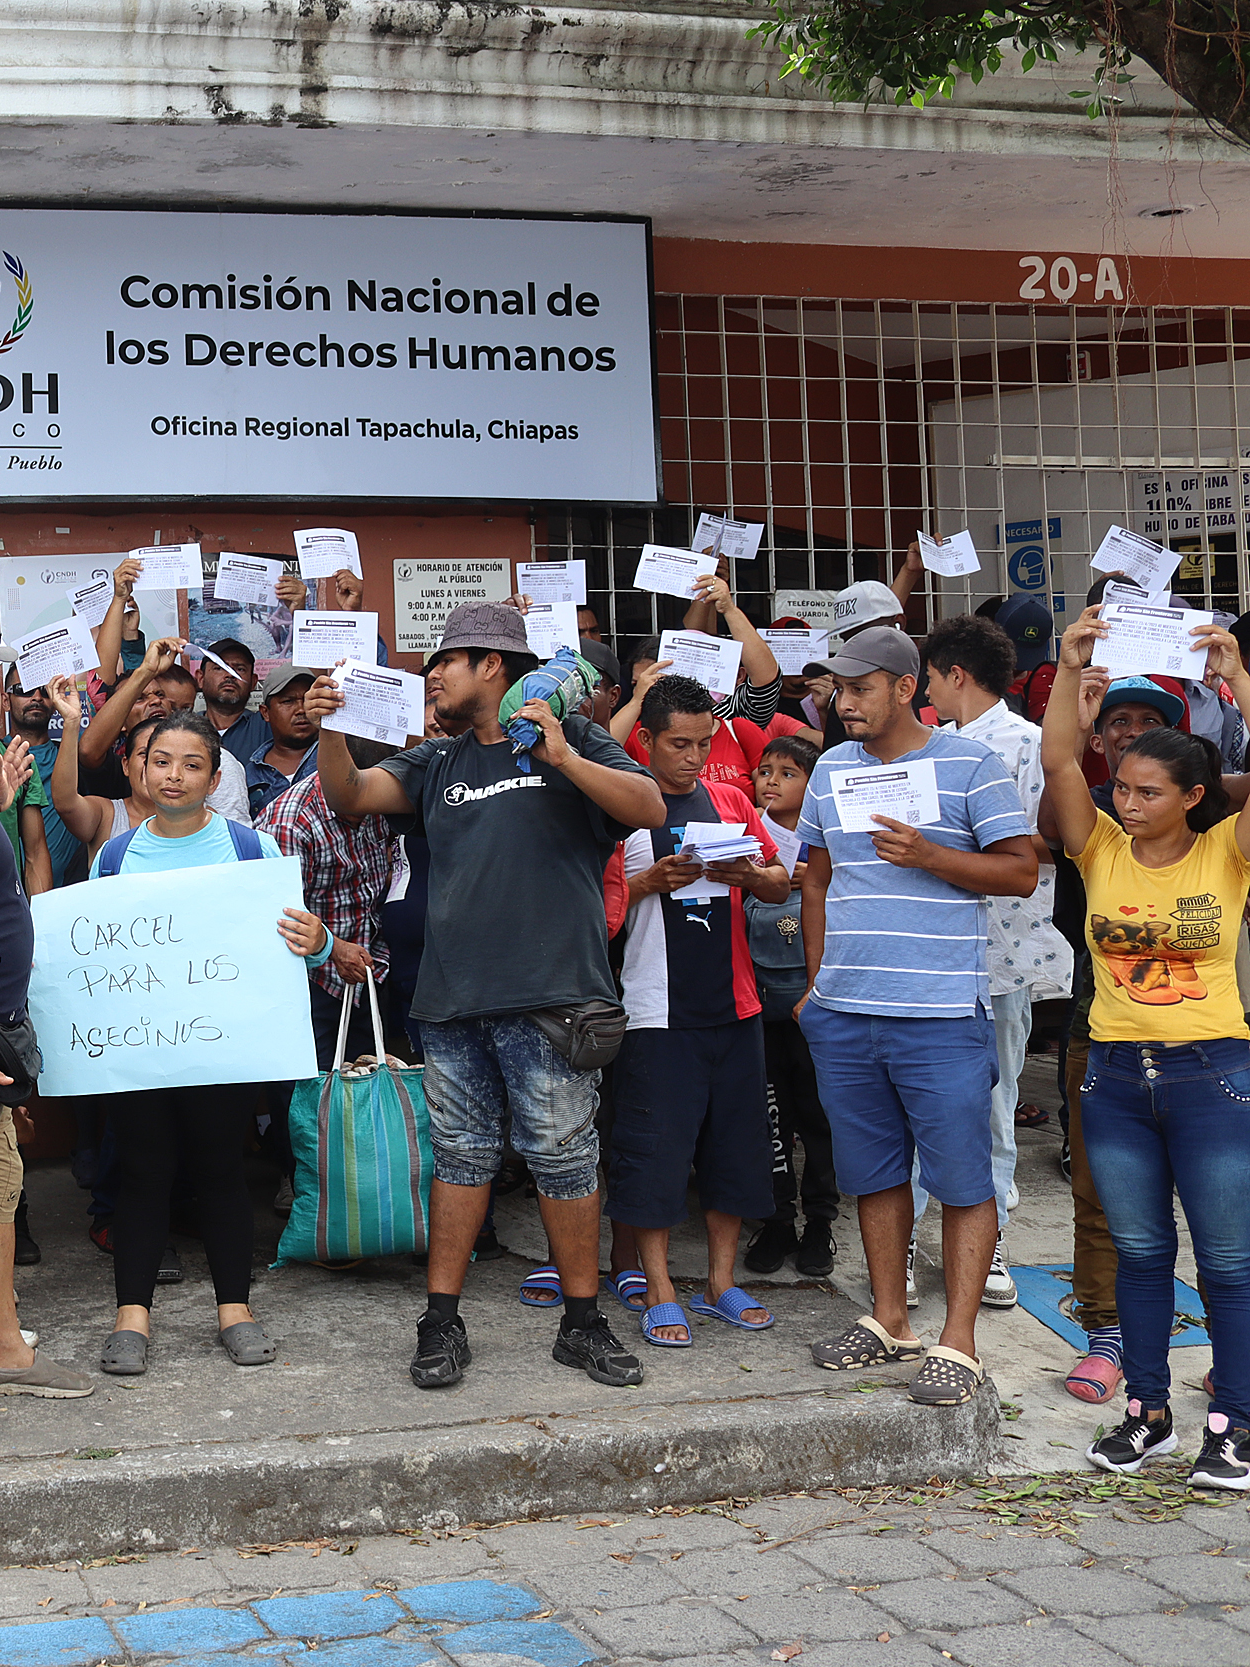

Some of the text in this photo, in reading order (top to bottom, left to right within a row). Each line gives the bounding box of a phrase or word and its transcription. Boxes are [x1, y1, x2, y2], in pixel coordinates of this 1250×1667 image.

[1019, 255, 1124, 302] 20-A
[120, 273, 600, 318] Comisión Nacional de
[106, 330, 617, 372] los Derechos Humanos
[150, 415, 579, 444] Oficina Regional Tapachula, Chiapas
[7, 454, 63, 470] Pueblo
[1145, 482, 1171, 494] ESA
[1181, 476, 1228, 491] OFIINA
[1205, 497, 1232, 510] IBRE
[1185, 517, 1199, 529] DE
[417, 561, 503, 572] HORARIO DE ATENCIÓN
[438, 573, 482, 584] AL PÚBLICO
[421, 589, 445, 598] LUNES
[454, 589, 486, 598] VIERNES
[408, 602, 425, 610] 9:00
[426, 602, 445, 610] A.M.
[787, 599, 826, 607] TELÉFONO
[412, 613, 430, 622] 4:00
[1180, 896, 1209, 906] AMOR
[1180, 908, 1219, 918] FELICIDAD
[70, 914, 184, 956] CARCEL
[1181, 923, 1214, 935] RISAS
[67, 954, 240, 997] PARA LOS
